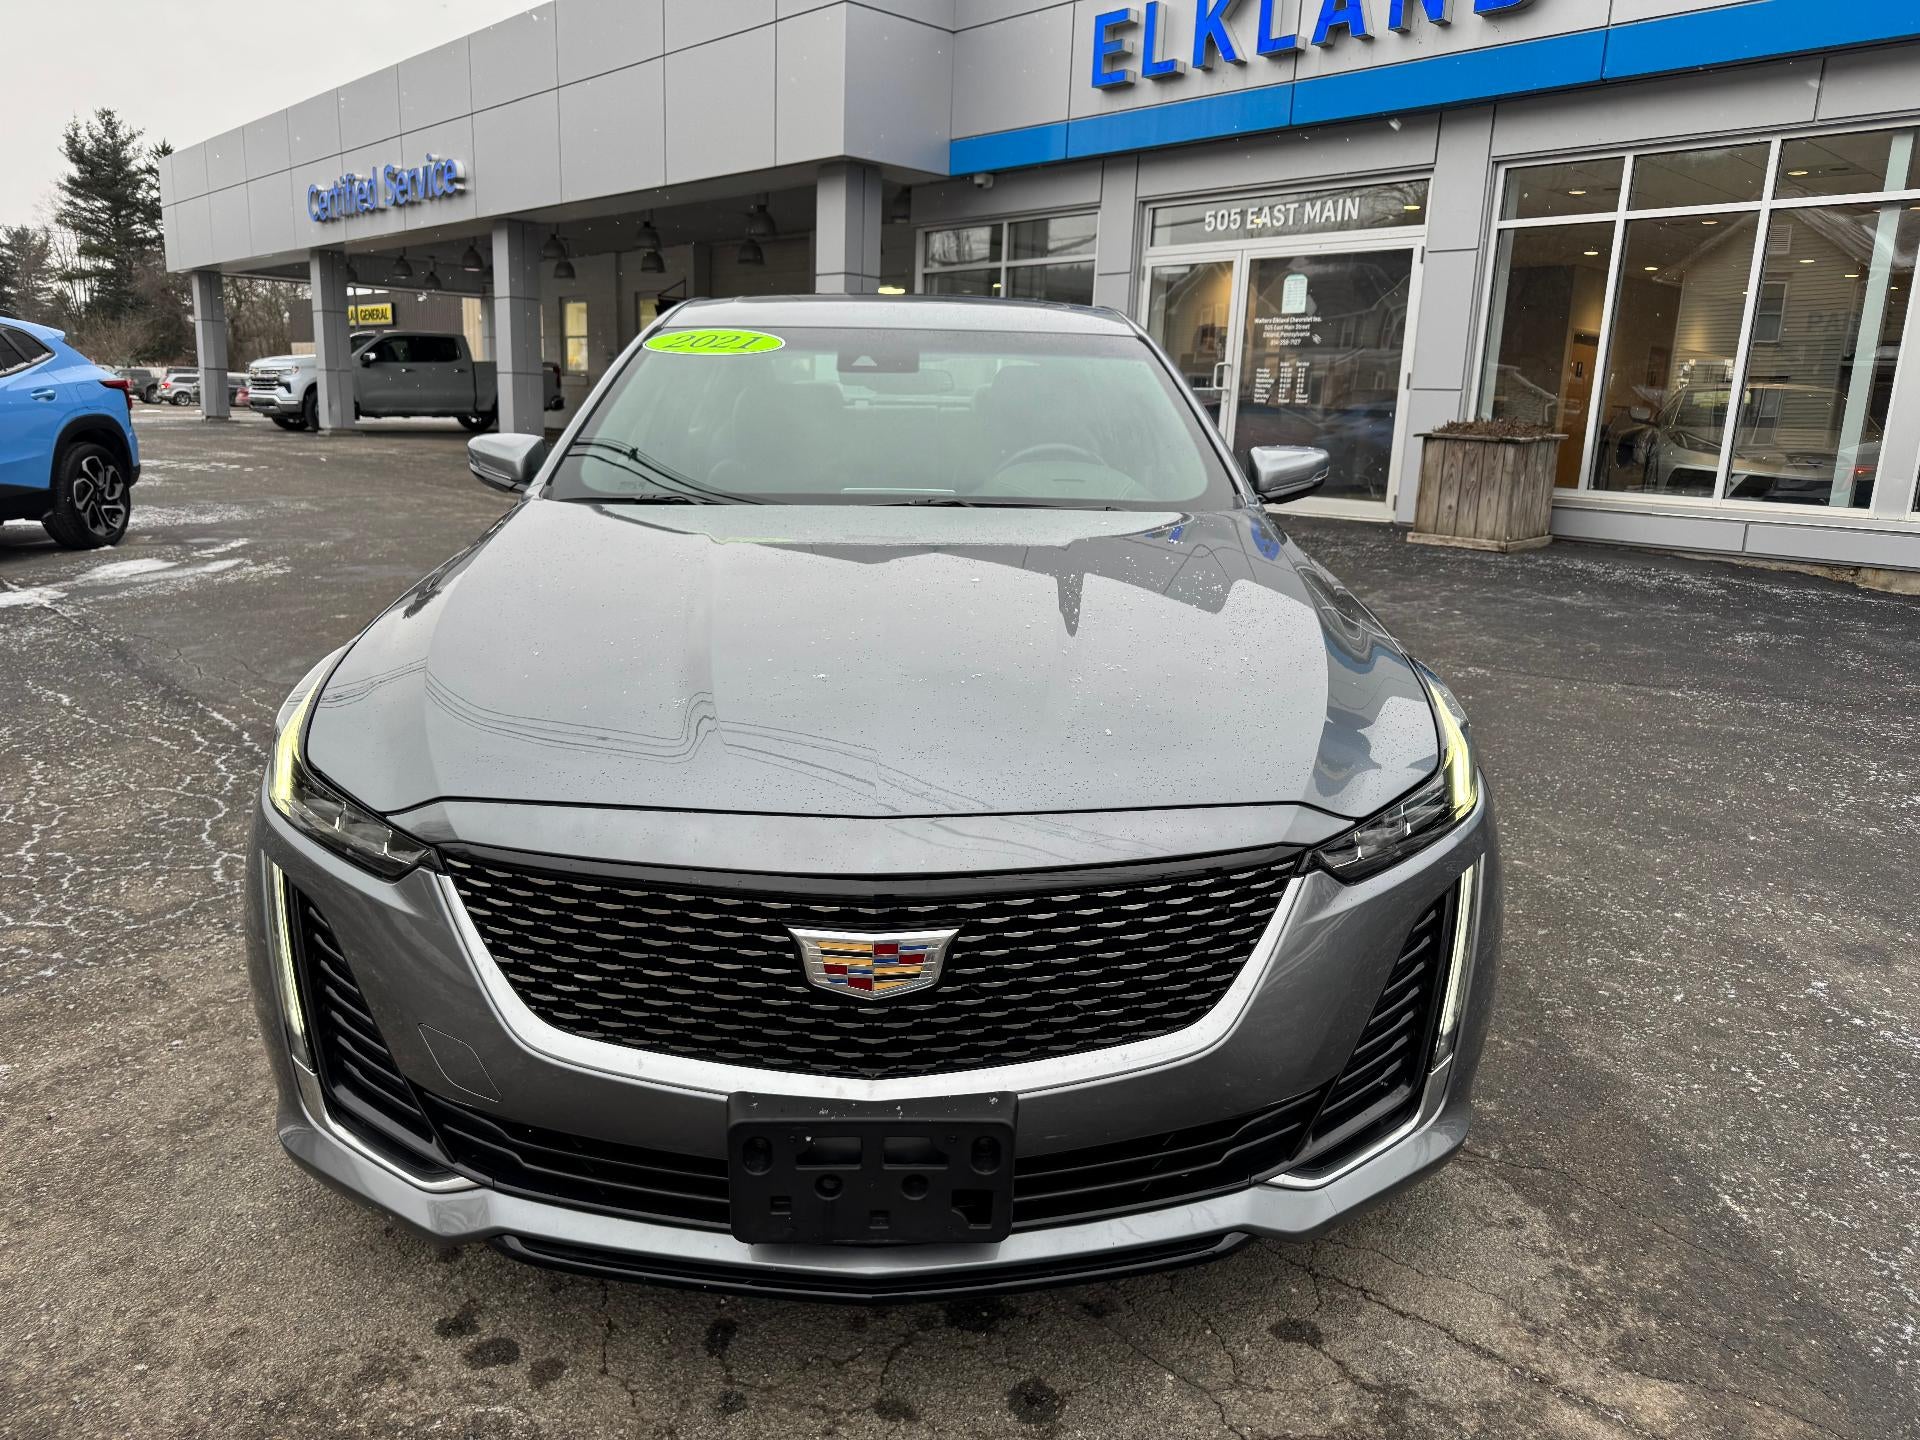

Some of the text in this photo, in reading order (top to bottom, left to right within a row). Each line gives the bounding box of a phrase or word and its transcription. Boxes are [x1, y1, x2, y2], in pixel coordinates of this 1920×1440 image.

[1092, 0, 1526, 88] ELKLA
[307, 153, 461, 222] Certified Service
[1204, 197, 1360, 232] 505 EAST MAIN
[360, 308, 389, 320] GENERAL
[662, 334, 764, 350] 2021
